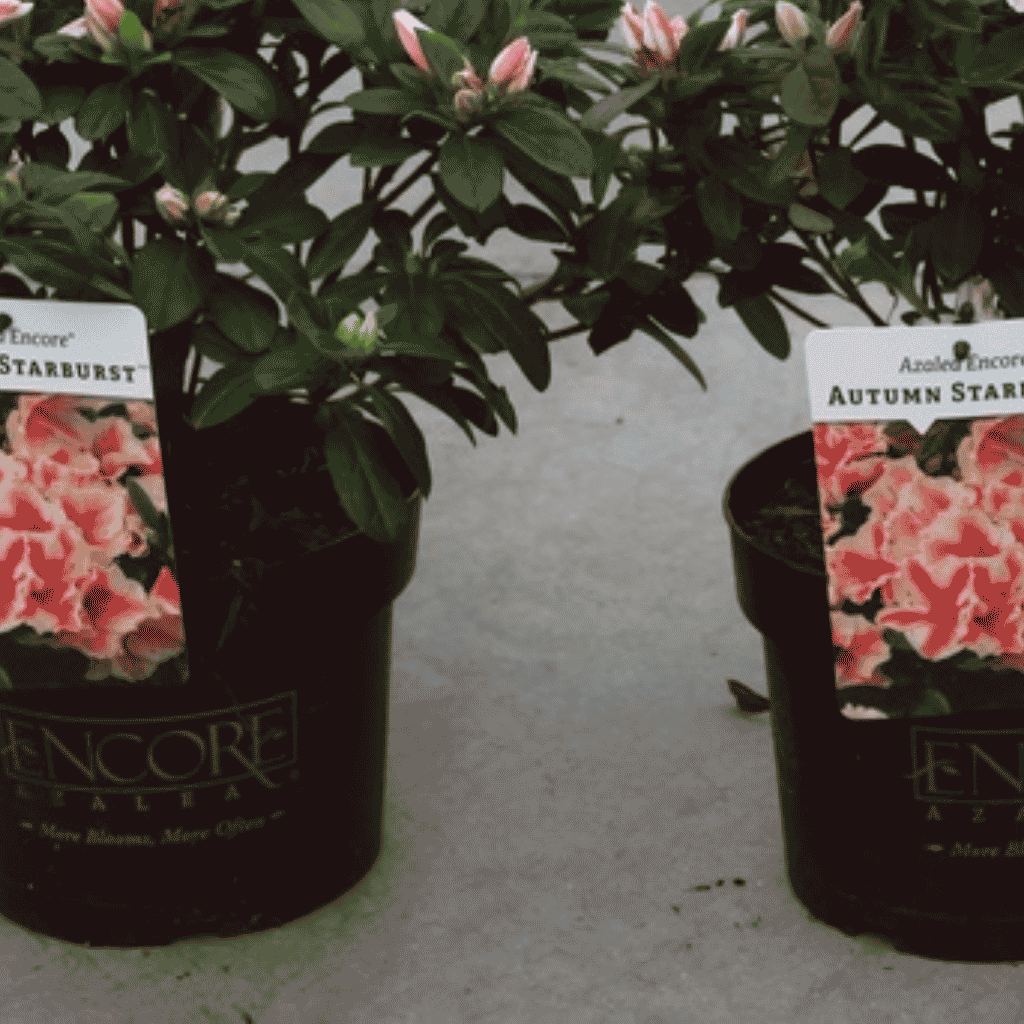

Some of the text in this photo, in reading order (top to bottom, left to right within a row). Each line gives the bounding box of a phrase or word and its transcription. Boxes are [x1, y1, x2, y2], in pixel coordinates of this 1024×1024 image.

[828, 385, 942, 406] AUTUMN
[0, 707, 286, 788] ENCORE
[160, 826, 211, 845] More
